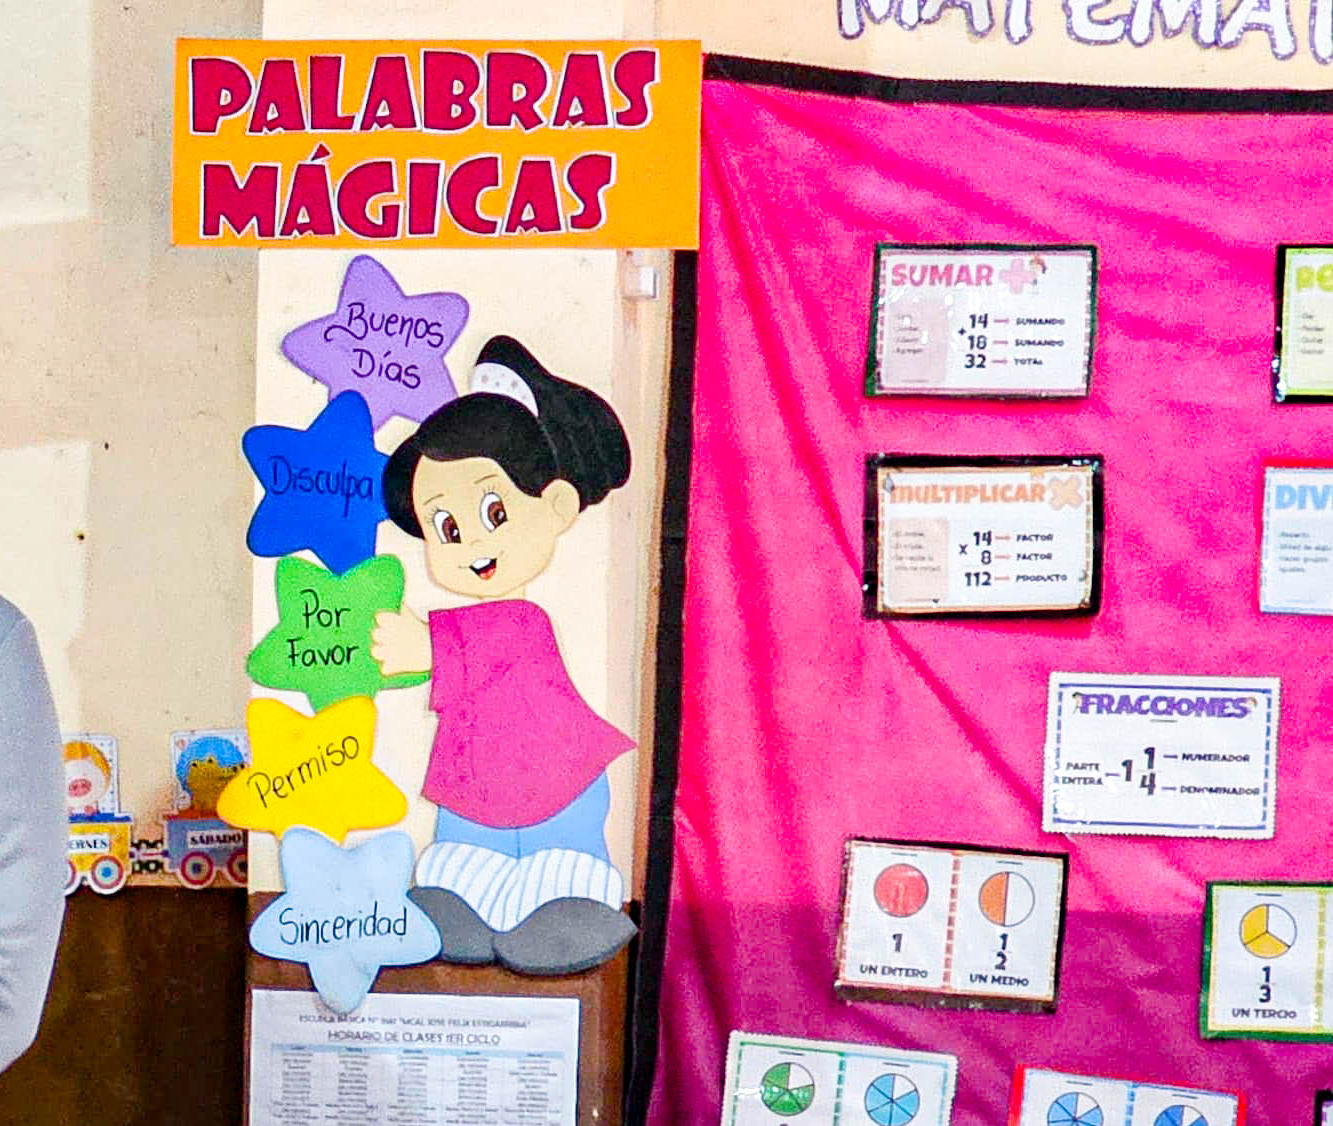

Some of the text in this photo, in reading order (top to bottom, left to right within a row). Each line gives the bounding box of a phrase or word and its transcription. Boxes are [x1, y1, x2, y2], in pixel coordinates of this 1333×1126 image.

[188, 47, 660, 135] PALABRAS
[200, 140, 617, 240] MÁGICAS
[892, 264, 993, 286] SUMAR
[324, 302, 444, 347] Buenos
[969, 314, 1065, 328] 14 SUMANDO
[968, 335, 1064, 350] 18 SUMANDO
[352, 349, 421, 389] Días
[965, 354, 986, 368] 32
[269, 456, 373, 517] Disculpa
[1275, 485, 1333, 510] DIV
[973, 530, 1053, 546] 14 FACTOR
[981, 550, 1053, 565] 8 FACTOR
[965, 572, 992, 586] 112
[301, 589, 351, 629] Por
[287, 637, 359, 669] Favor
[1080, 694, 1250, 719] FRACCIONES
[1144, 747, 1155, 769] 1
[247, 735, 359, 808] Permiso
[279, 901, 407, 944] Sinceridad
[892, 933, 903, 952] 1
[999, 933, 1008, 950] 1
[995, 952, 1007, 970] 2
[860, 964, 928, 978] UN ENTERO
[970, 973, 1029, 987] UN MEDIO
[1262, 966, 1271, 983] 1
[1259, 984, 1271, 1003] 3
[1232, 1008, 1297, 1019] UN TERCIO
[328, 1031, 381, 1043] HORARIO
[384, 1032, 399, 1043] DE
[401, 1031, 443, 1044] CLASES
[466, 1033, 501, 1046] CICLO
